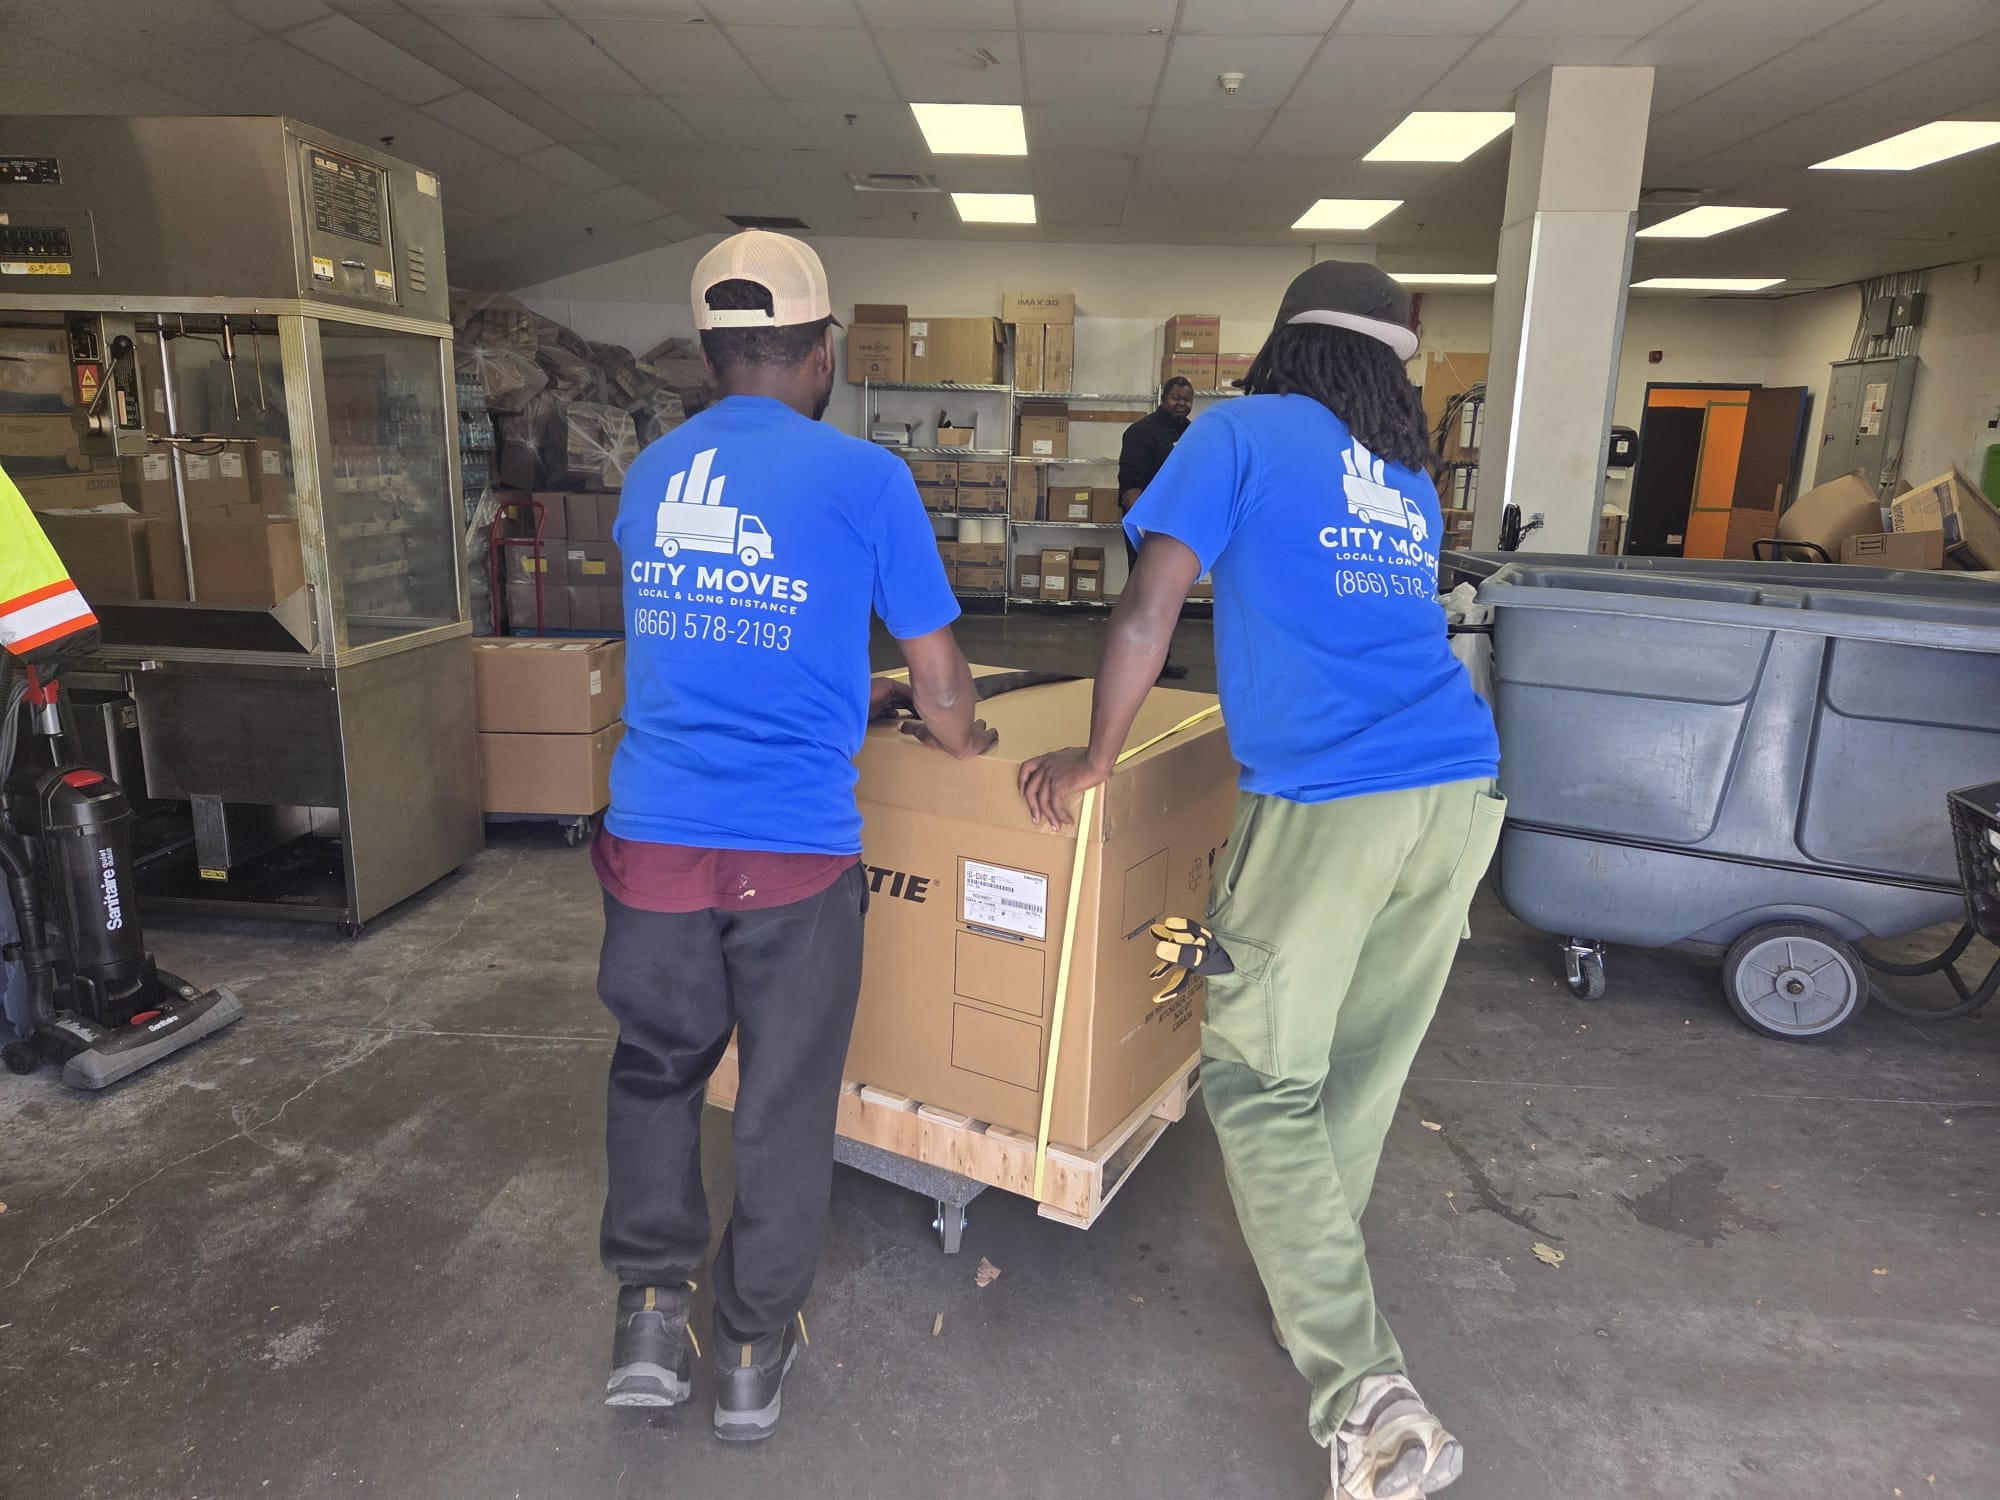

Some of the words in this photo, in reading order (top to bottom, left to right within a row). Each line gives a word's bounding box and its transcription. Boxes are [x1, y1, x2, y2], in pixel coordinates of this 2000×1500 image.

[1018, 298, 1043, 306] IMAX
[1319, 526, 1383, 550] CITY
[1336, 553, 1375, 562] LOCAL
[630, 560, 686, 586] CITY
[696, 566, 809, 602] MOVES
[1335, 569, 1389, 597] (866)
[638, 588, 670, 599] LOCAL
[674, 591, 682, 600] &
[687, 592, 724, 605] LONG
[730, 597, 798, 615] DISTANCE
[634, 608, 677, 641] (866)
[684, 613, 792, 651] 578-2193
[863, 864, 931, 904] TIE
[101, 868, 123, 931] Sanitaire
